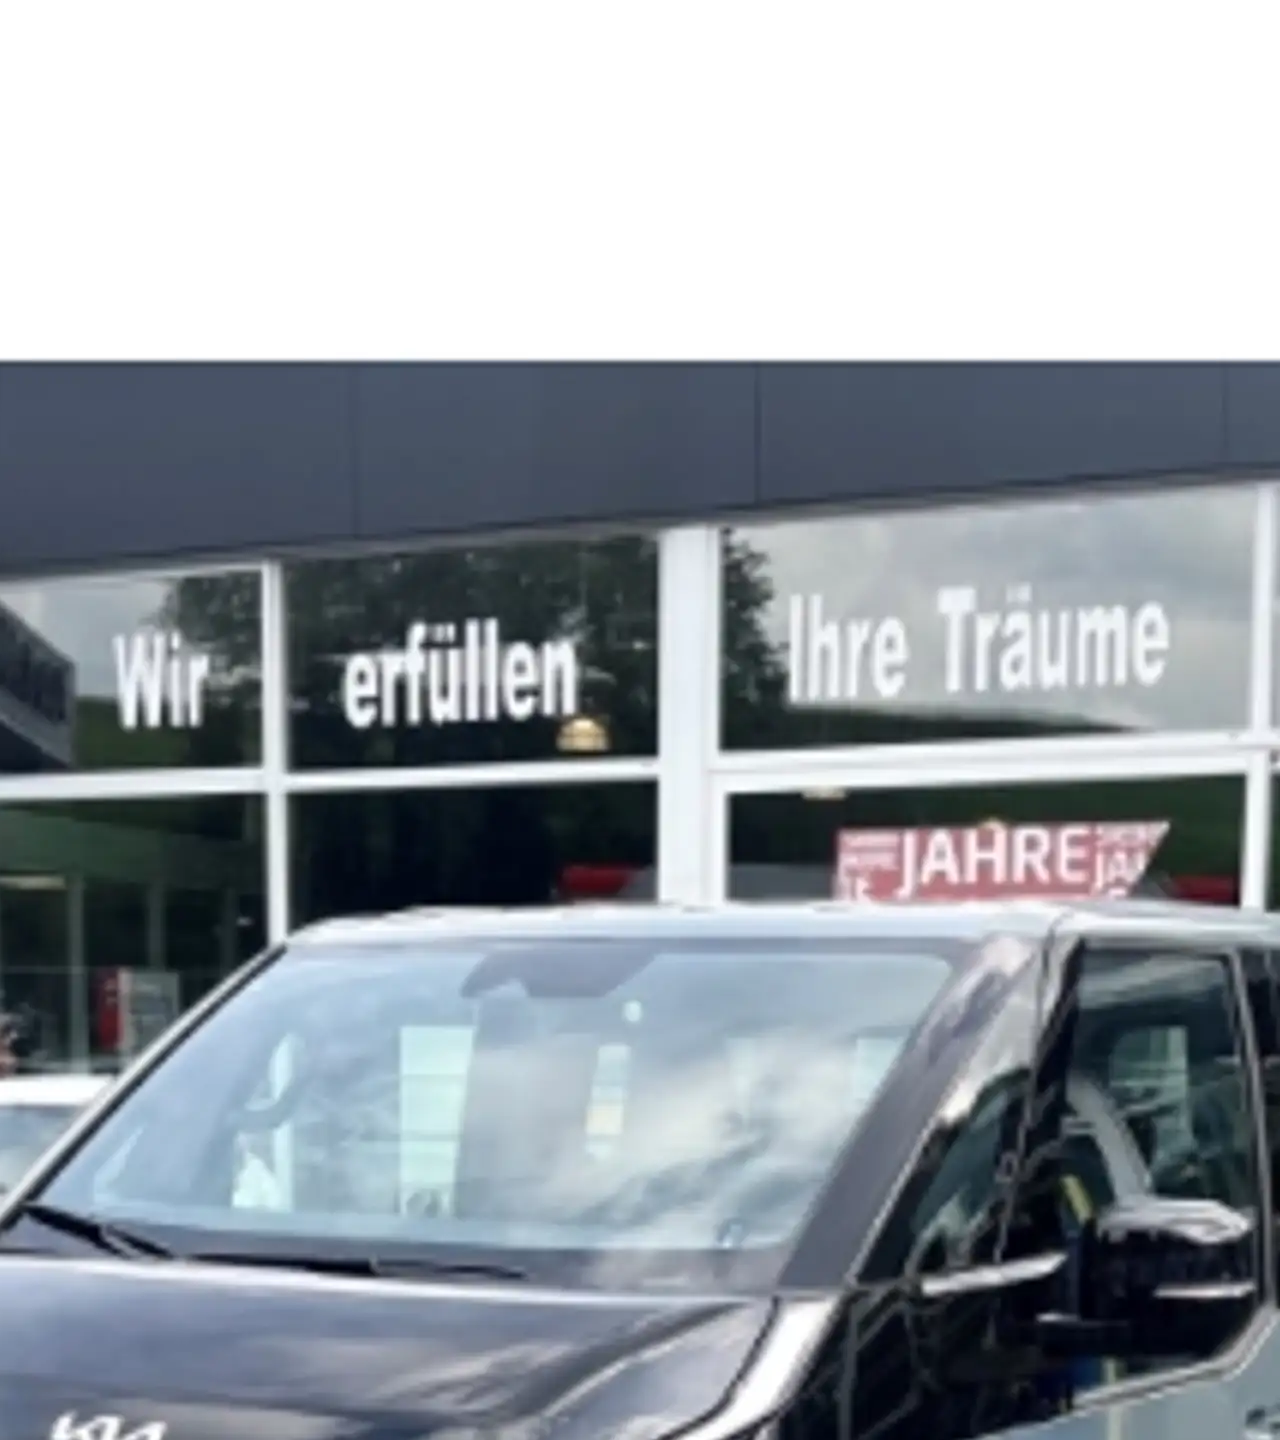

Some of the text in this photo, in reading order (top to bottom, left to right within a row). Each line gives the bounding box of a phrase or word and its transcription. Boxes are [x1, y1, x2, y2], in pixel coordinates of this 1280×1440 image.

[112, 629, 209, 730] Wir
[342, 617, 577, 729] erfüllen
[788, 594, 909, 702] Ihre
[937, 583, 1171, 694] Träume
[892, 827, 1088, 899] JAHRE
